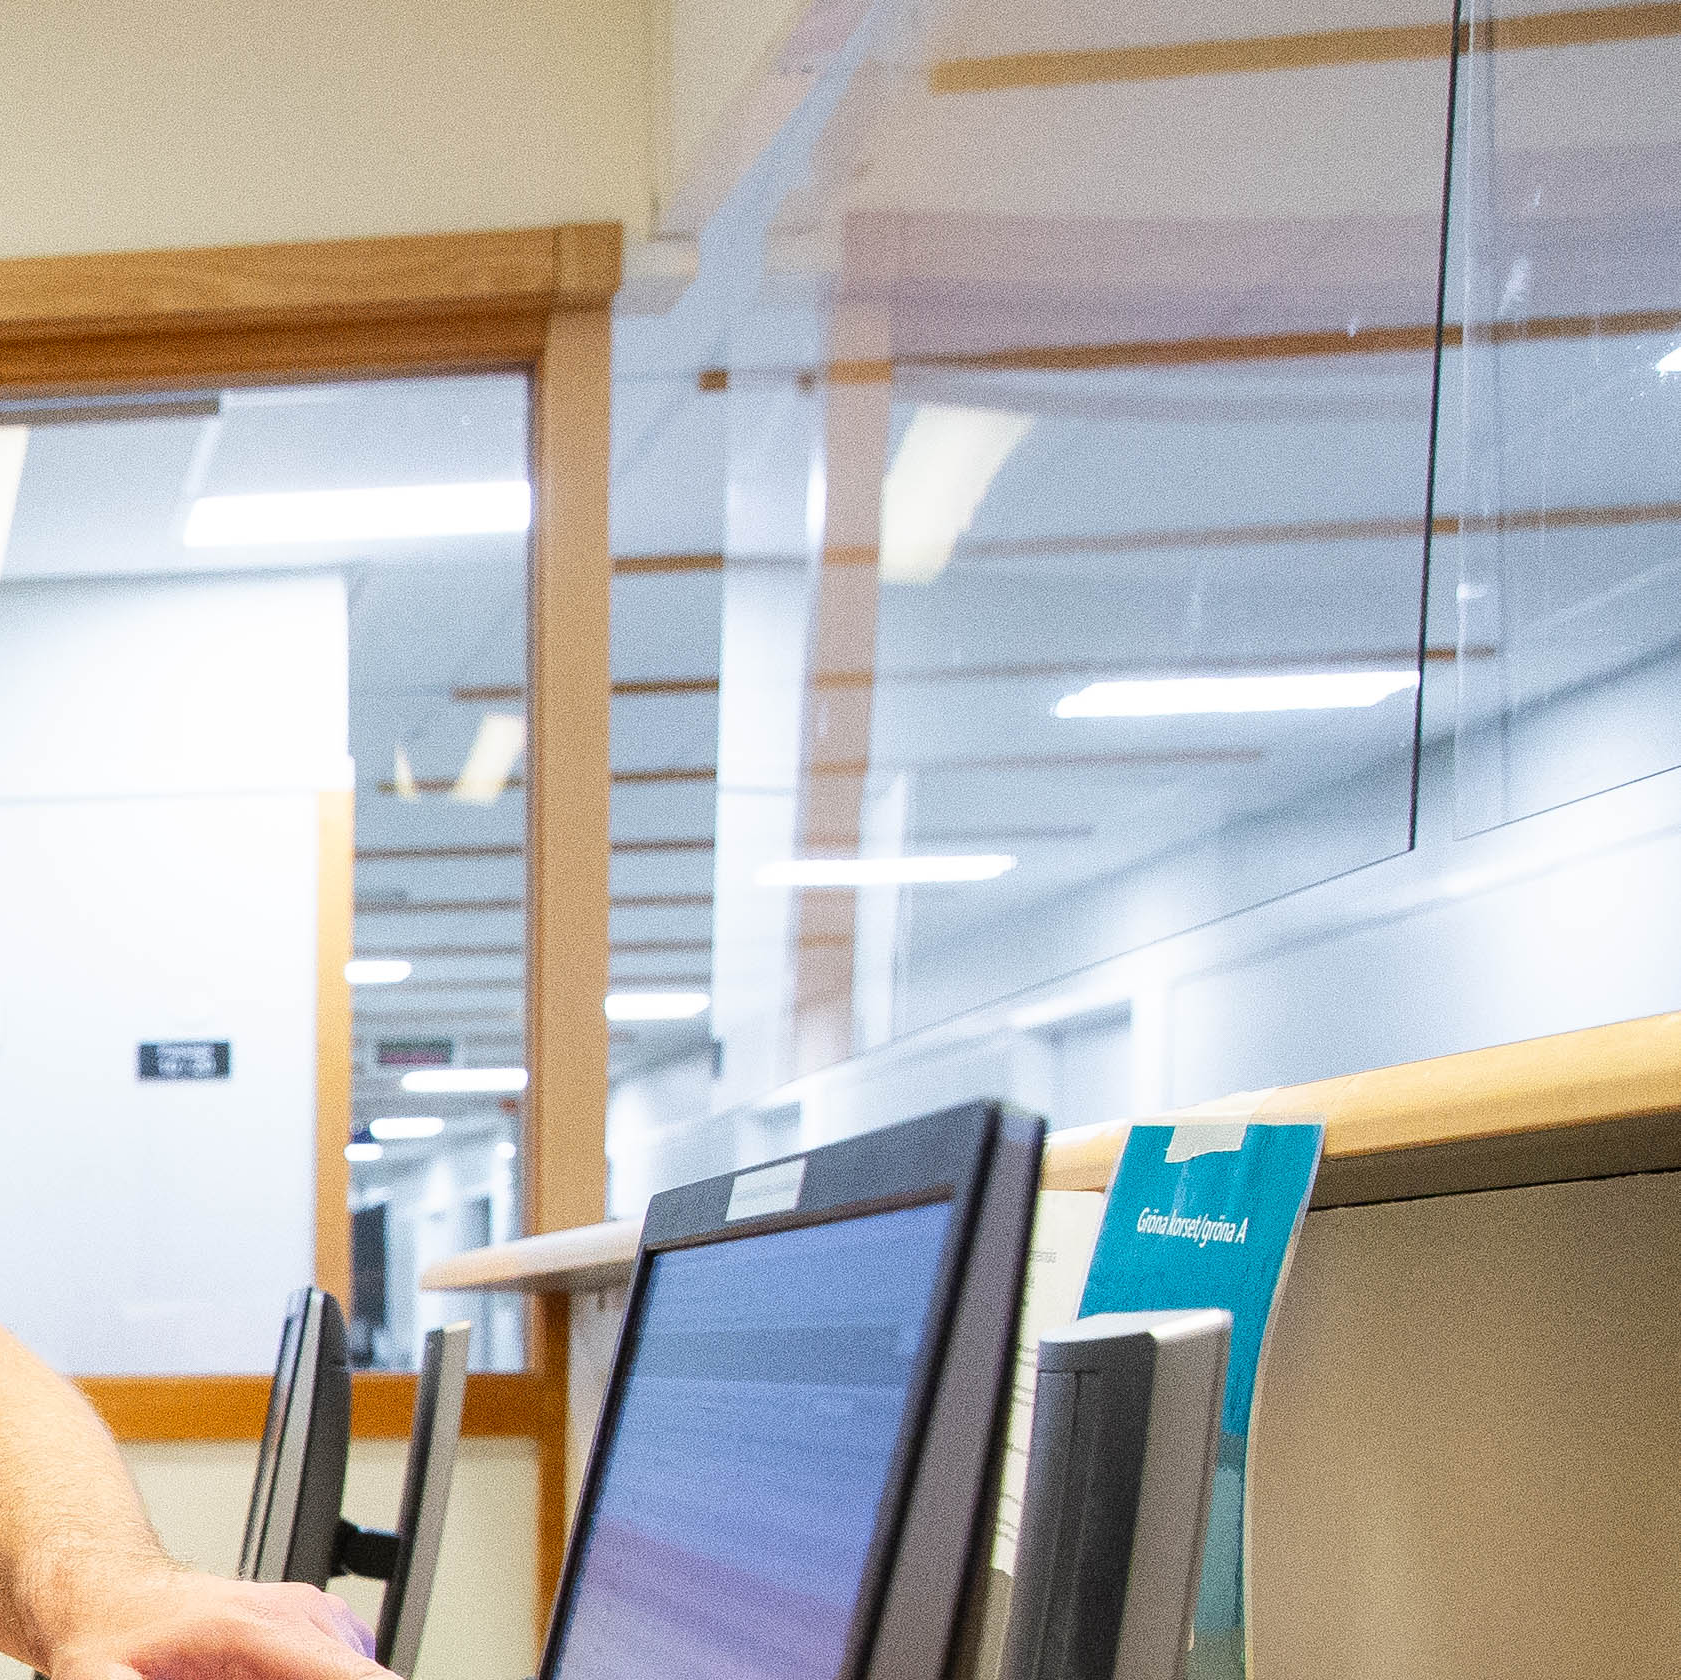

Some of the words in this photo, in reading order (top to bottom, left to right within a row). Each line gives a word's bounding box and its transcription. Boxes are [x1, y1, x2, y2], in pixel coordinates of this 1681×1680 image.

[1137, 1206, 1169, 1236] Gröna
[1166, 1208, 1237, 1249] korset/gröna
[1234, 1216, 1249, 1244] A
